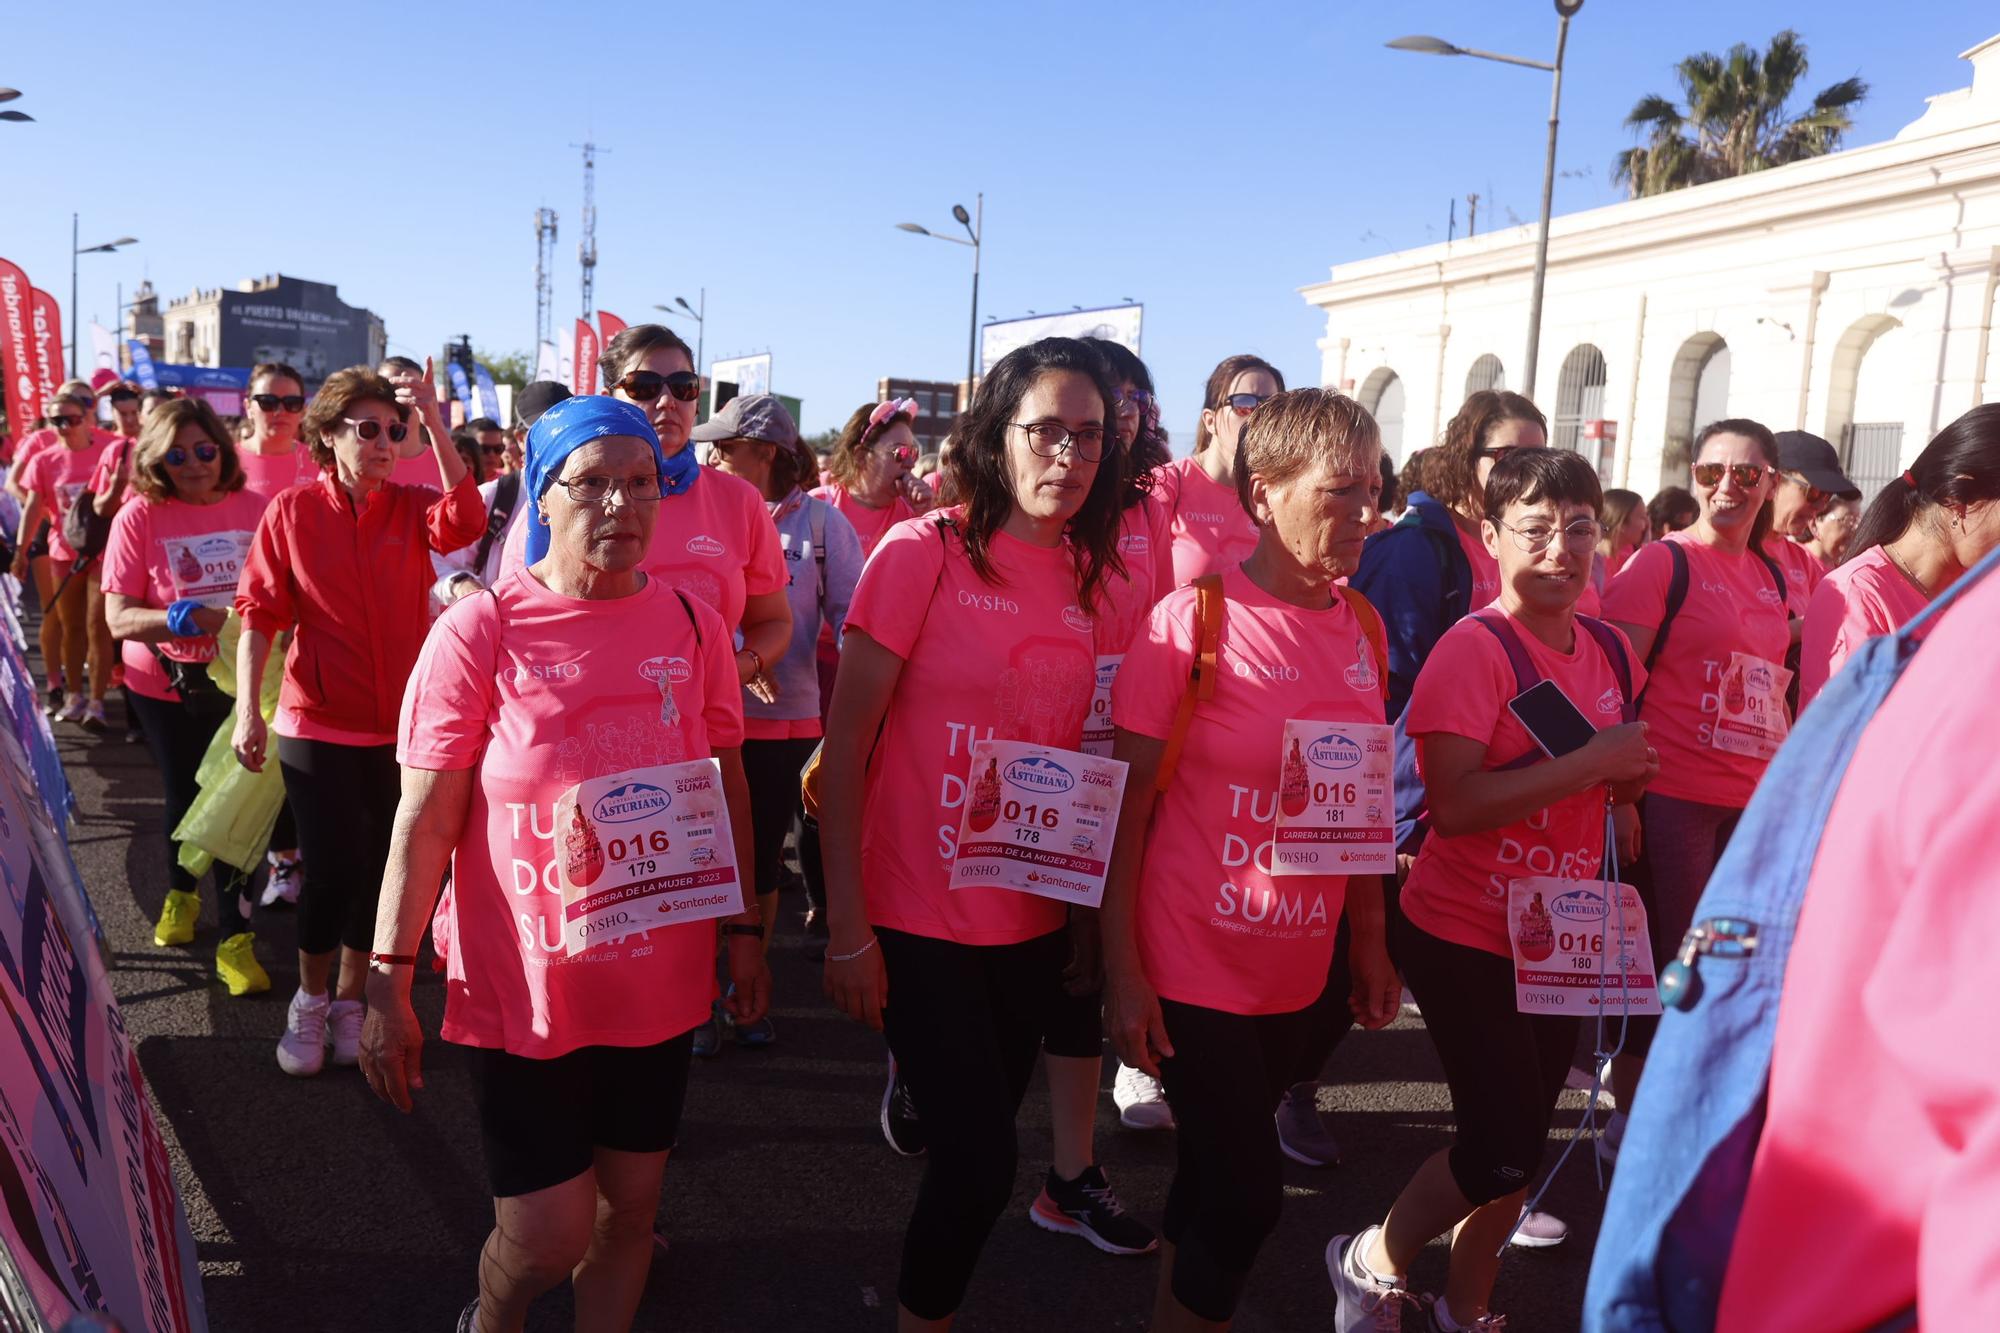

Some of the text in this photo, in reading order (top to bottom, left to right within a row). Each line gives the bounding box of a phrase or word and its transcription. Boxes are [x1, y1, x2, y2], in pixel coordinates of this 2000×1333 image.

[1185, 512, 1224, 523] OYSHO
[204, 560, 237, 575] 016
[958, 590, 1019, 615] OYSHO
[504, 663, 580, 683] OYSHO
[1234, 661, 1299, 682] OYSHO
[1101, 716, 1114, 727] 18
[1312, 746, 1358, 762] ASTURIANA
[1366, 744, 1387, 753] SUMA
[684, 776, 711, 784] DORSAL
[1007, 766, 1069, 789] ASTURIANA
[1081, 774, 1113, 788] SUMA
[676, 781, 712, 793] SUMA
[1313, 782, 1356, 804] 016
[599, 797, 667, 819] ASTURIANA
[1229, 783, 1278, 823] TU
[505, 802, 558, 840] TU
[1003, 800, 1060, 828] 016
[1326, 809, 1344, 822] 181
[1015, 828, 1040, 844] 178
[1283, 831, 1383, 840] CARRERA DE LA MUJER 2023
[608, 830, 670, 861] 016
[967, 845, 1092, 871] CARRERA DE LA MUJER 2023
[1280, 851, 1387, 864] OYSHO Santander
[628, 860, 657, 877] 179
[961, 864, 1092, 893] OYSHO Santander
[579, 872, 721, 912] CARRERA DE LA MUJER 2023
[673, 894, 729, 911] Santander
[1215, 881, 1327, 927] SUMA
[579, 911, 629, 938] OYSHO
[1210, 917, 1251, 935] CARRERA
[1559, 932, 1604, 953] 016
[585, 951, 619, 963] MUJER
[631, 945, 654, 958] 2023
[1571, 957, 1592, 969] 180
[1526, 974, 1564, 984] CARRERA
[1566, 976, 1577, 984] DE
[1578, 977, 1588, 985] LA
[1589, 977, 1619, 985] MUJER
[1525, 991, 1565, 1005] OYSHO
